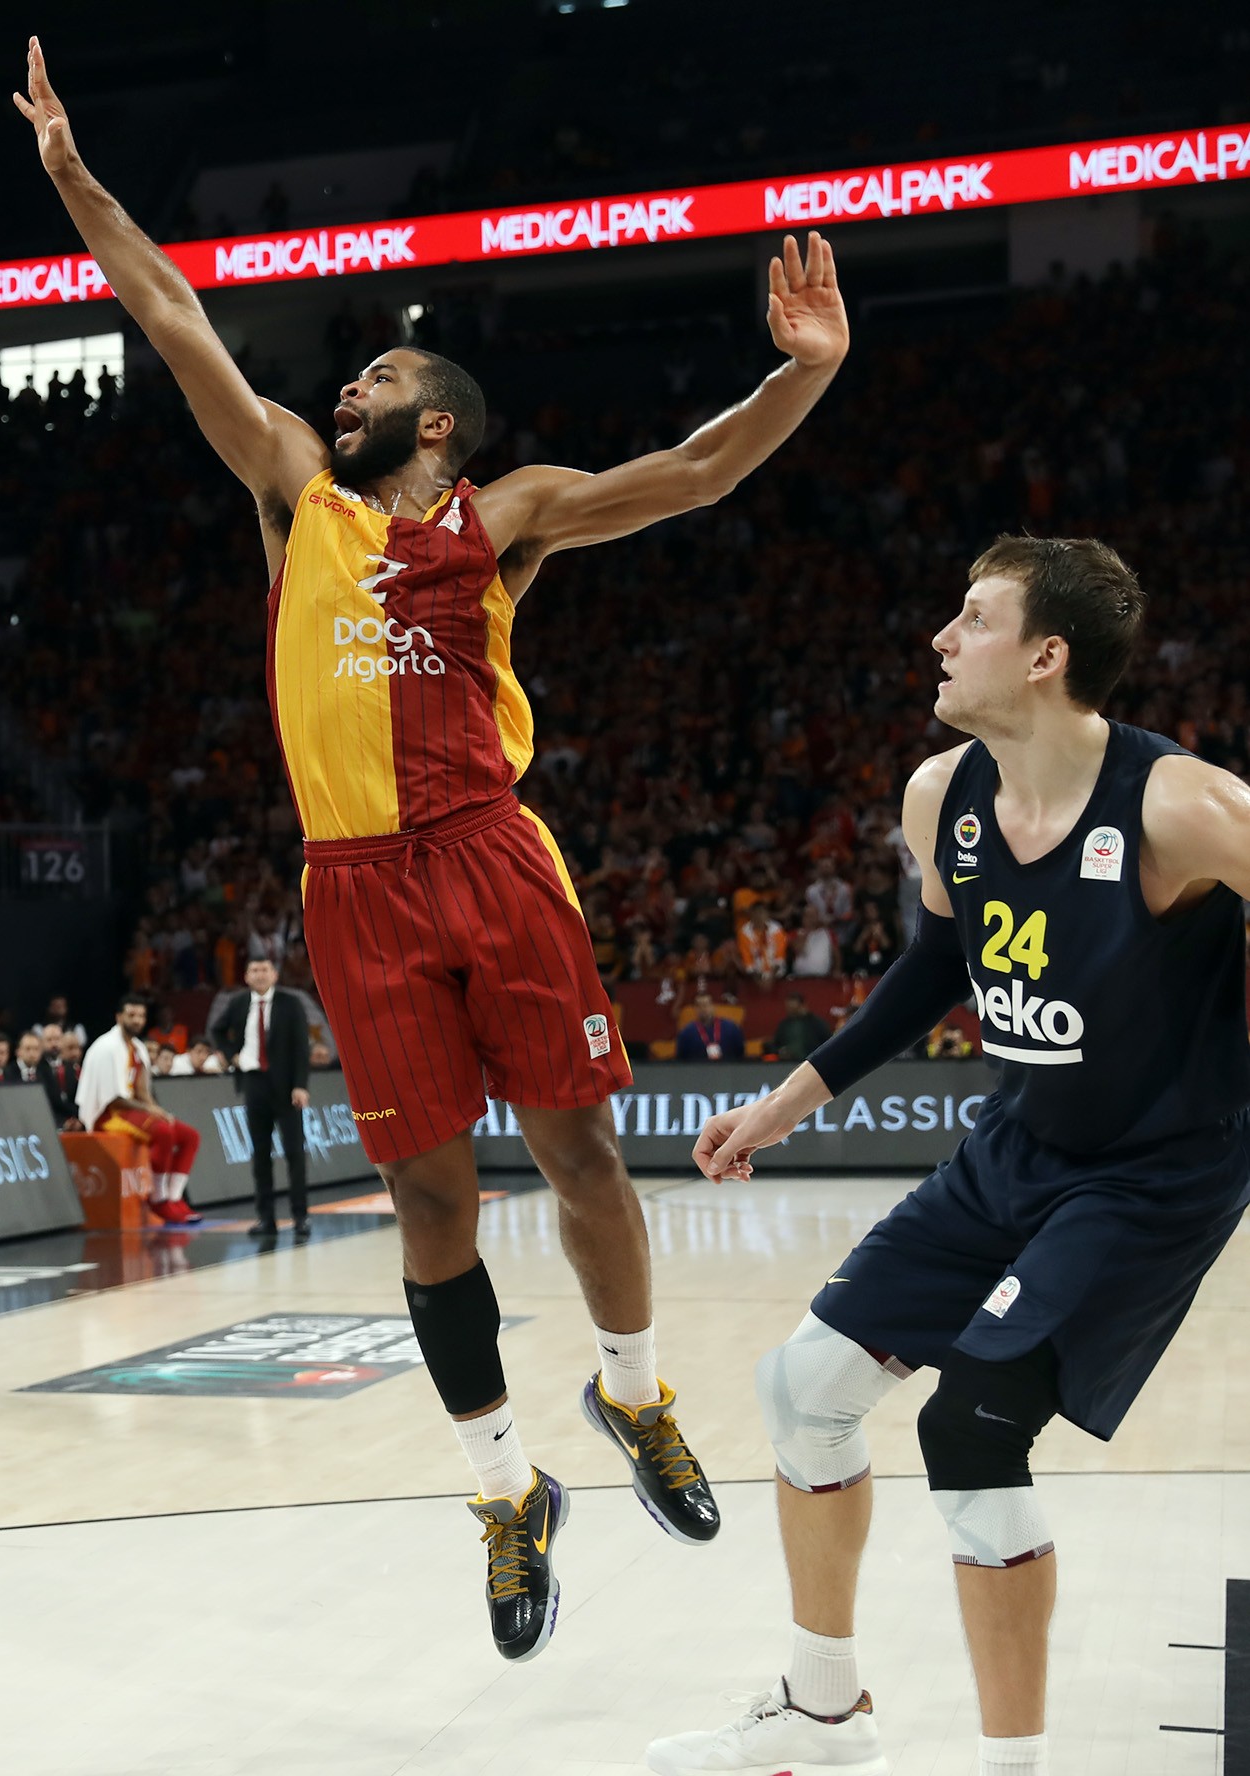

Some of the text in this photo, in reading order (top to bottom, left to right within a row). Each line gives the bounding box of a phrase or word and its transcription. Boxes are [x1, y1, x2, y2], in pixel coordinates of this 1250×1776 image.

[308, 494, 356, 520] GIVOVA
[334, 652, 445, 682] sigorta
[27, 850, 85, 883] 126
[957, 851, 978, 864] beko
[981, 900, 1049, 981] 24
